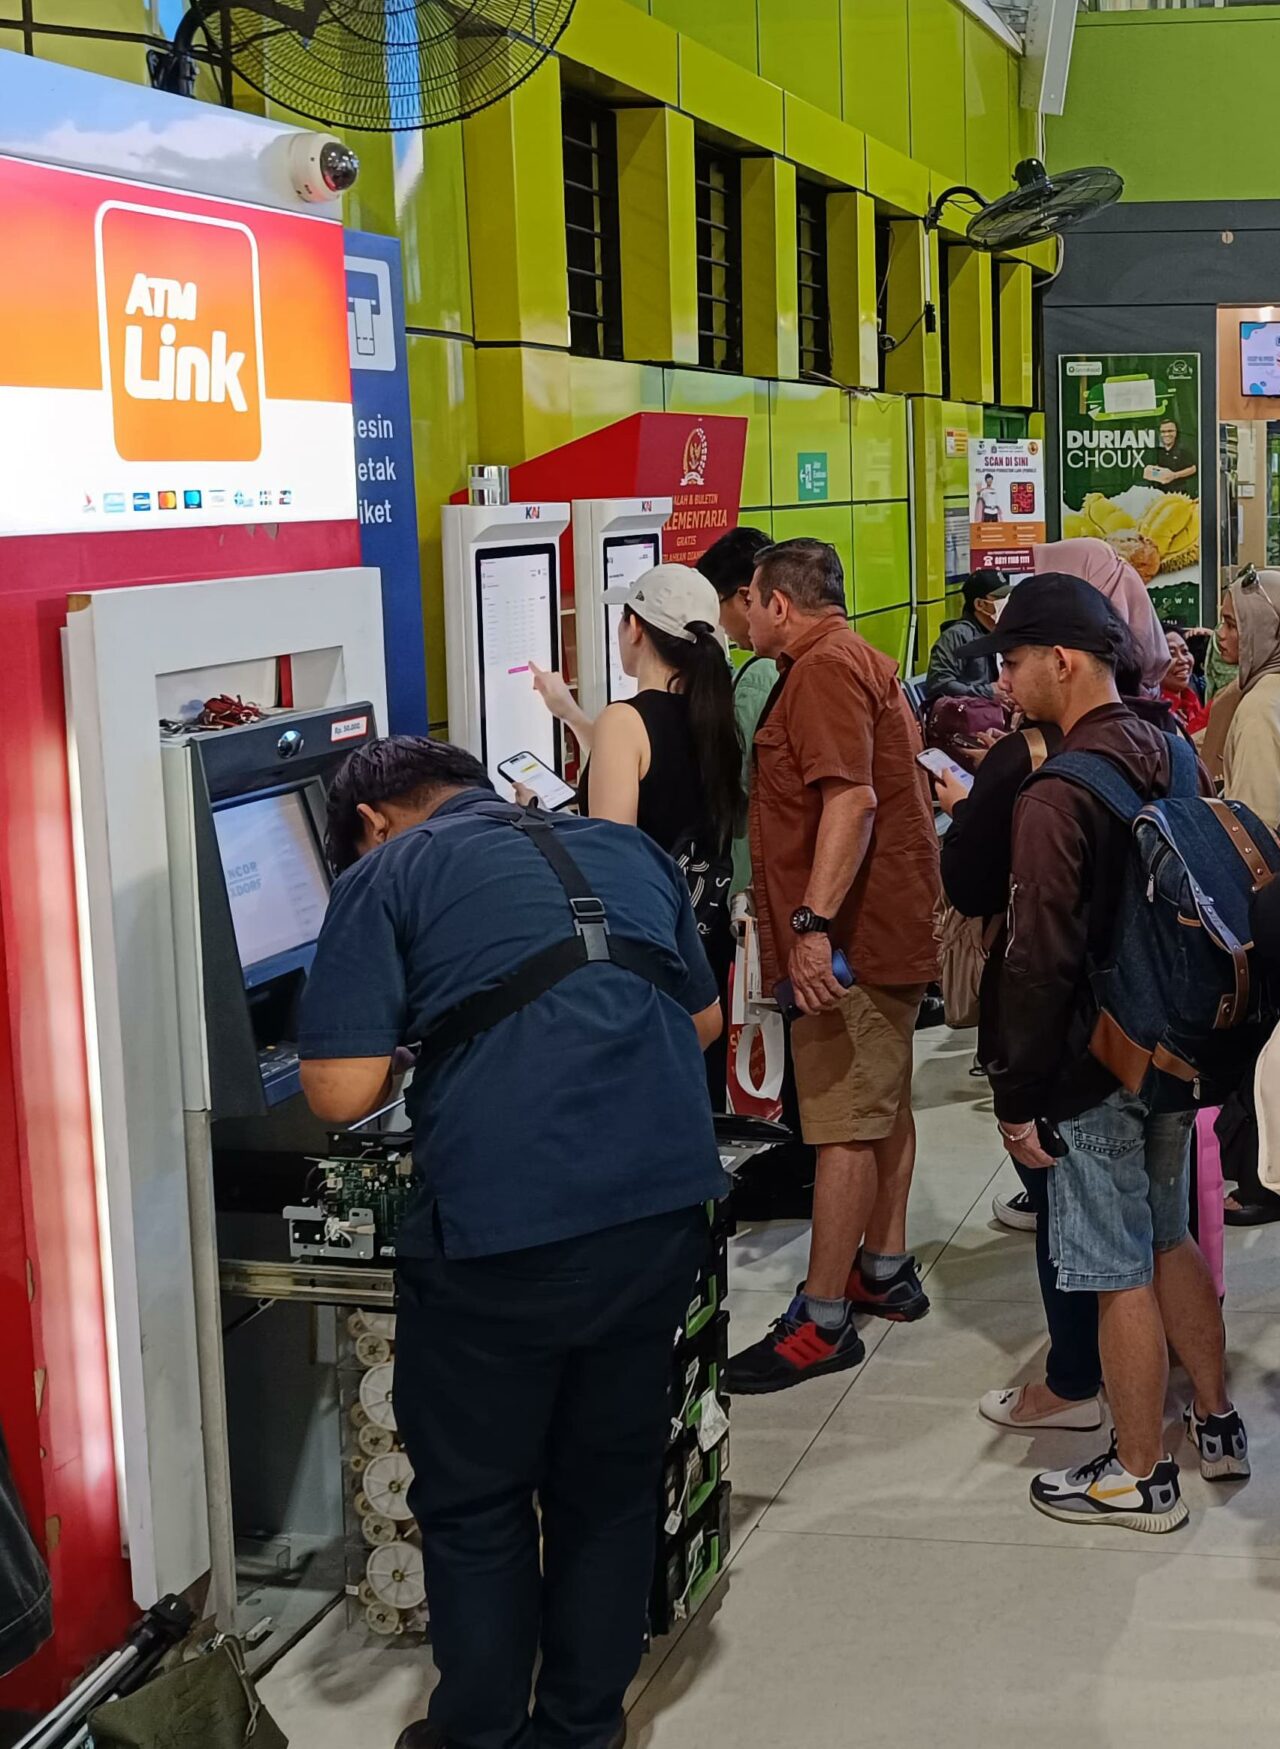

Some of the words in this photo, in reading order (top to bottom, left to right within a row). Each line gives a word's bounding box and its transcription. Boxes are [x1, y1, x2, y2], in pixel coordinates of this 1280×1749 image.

[124, 272, 198, 321] ATM
[124, 323, 249, 413] Link
[357, 413, 394, 439] esin
[1066, 430, 1155, 449] DURIAN
[358, 455, 397, 482] etak
[984, 456, 1005, 467] SCAN
[1005, 456, 1013, 467] DI
[1014, 456, 1029, 467] SINI
[1067, 450, 1145, 469] CHOUX
[359, 499, 393, 525] iket
[663, 509, 728, 531] LEMENTARIA
[676, 535, 697, 546] GRATIS
[228, 861, 258, 879] NCOR
